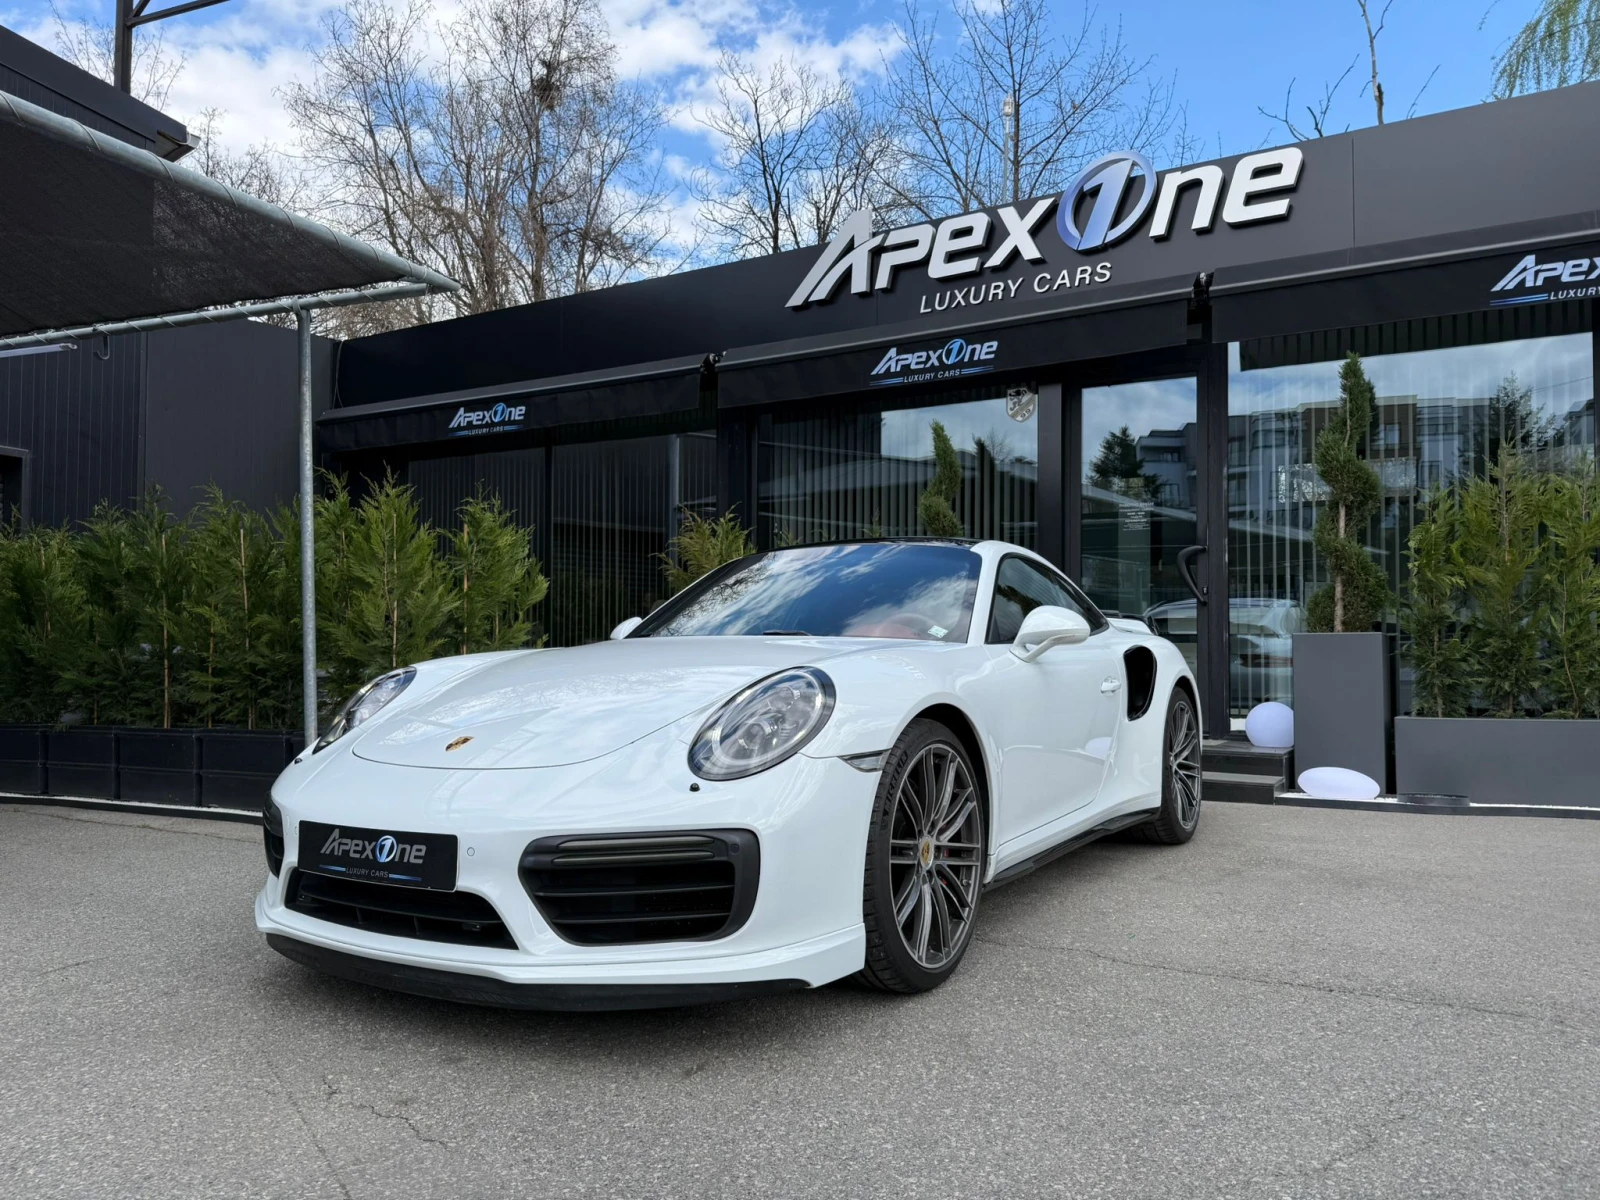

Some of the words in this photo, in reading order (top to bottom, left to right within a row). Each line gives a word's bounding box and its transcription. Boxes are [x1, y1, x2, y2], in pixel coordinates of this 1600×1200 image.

[920, 275, 1024, 314] LUXURY
[1033, 262, 1112, 295] CARS
[1550, 286, 1600, 300] LUXUR
[904, 372, 935, 383] LUXURY
[938, 368, 960, 379] CARS
[468, 427, 490, 436] LUXURY
[490, 425, 504, 433] CARS
[345, 866, 369, 876] LUXURY
[370, 869, 389, 879] CARS
